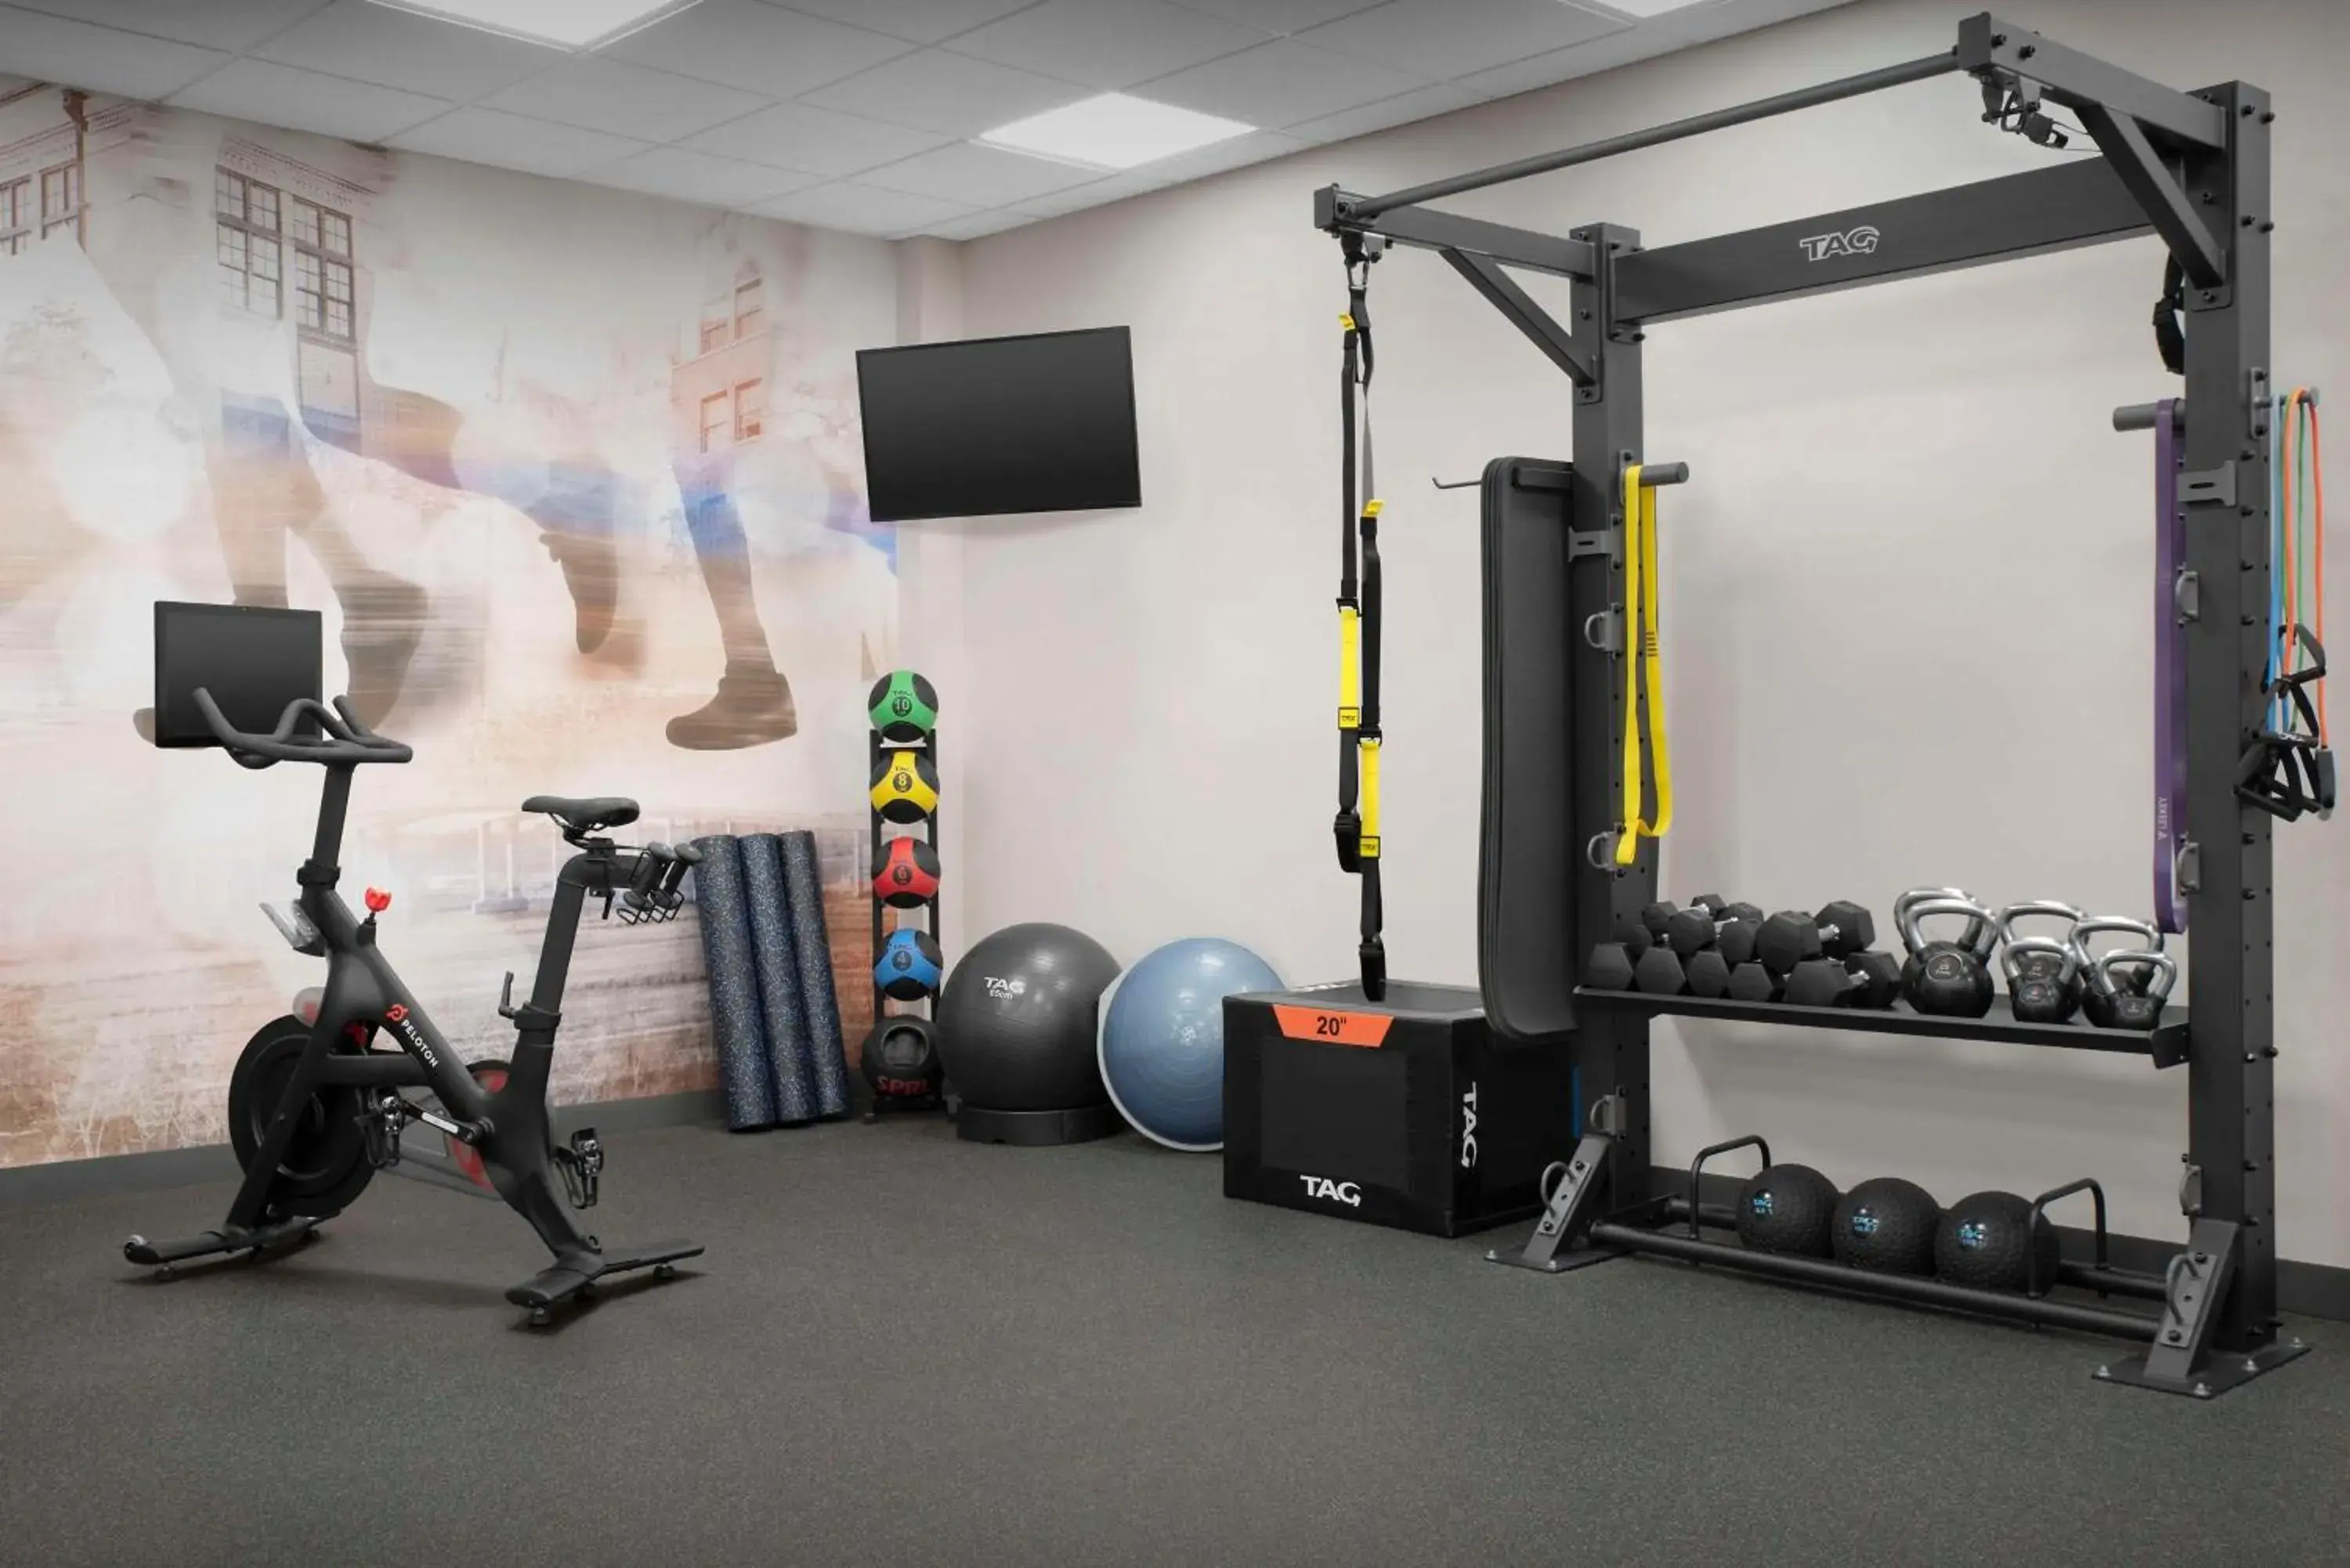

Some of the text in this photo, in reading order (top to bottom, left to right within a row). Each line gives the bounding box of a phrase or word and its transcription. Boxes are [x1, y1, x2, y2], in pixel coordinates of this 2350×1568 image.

[1799, 226, 1880, 261] TAG
[894, 698, 909, 710] 10
[898, 774, 907, 786] 8
[897, 865, 907, 879] 6
[897, 952, 907, 963] 4
[983, 977, 1027, 994] TAG
[1317, 1016, 1347, 1036] 20"
[401, 1019, 439, 1068] PELOTON
[1462, 1081, 1477, 1168] TAG
[1300, 1175, 1361, 1207] TAG
